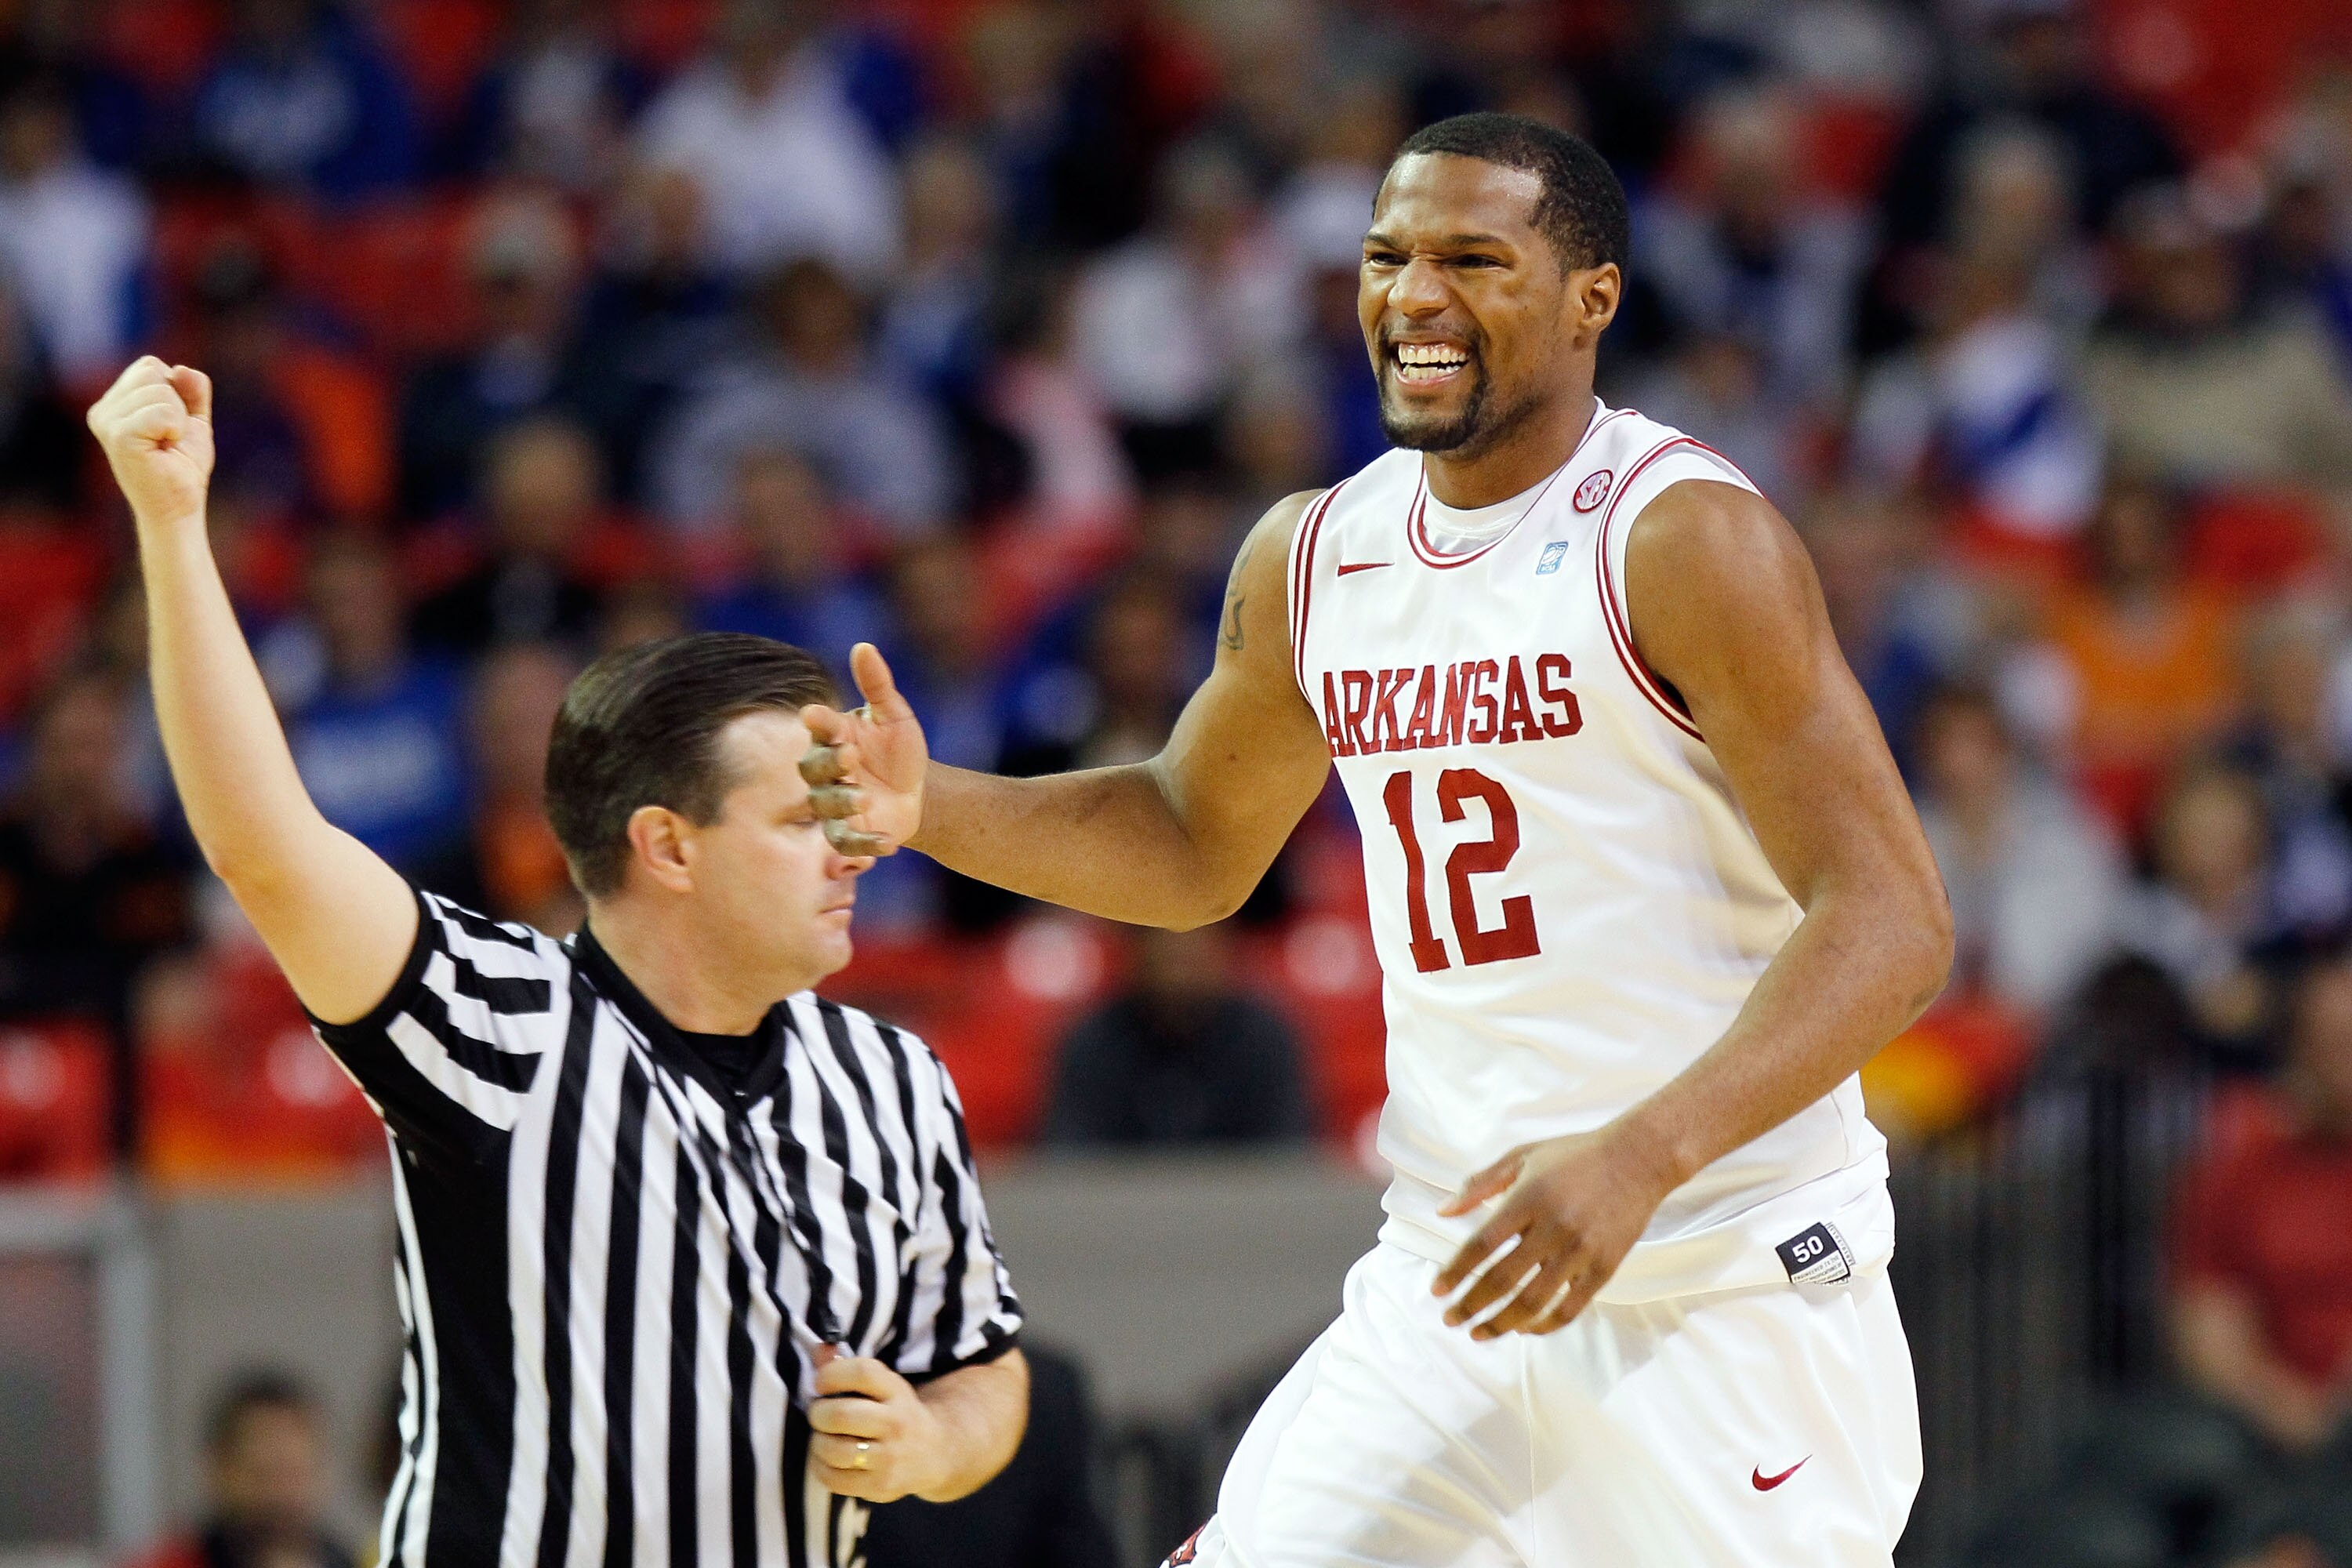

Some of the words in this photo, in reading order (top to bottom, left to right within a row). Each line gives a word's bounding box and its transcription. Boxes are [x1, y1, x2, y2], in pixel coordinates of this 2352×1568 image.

[1323, 654, 1584, 758] ARKANSAS
[1383, 768, 1541, 973] 12
[1791, 1235, 1824, 1263] 50
